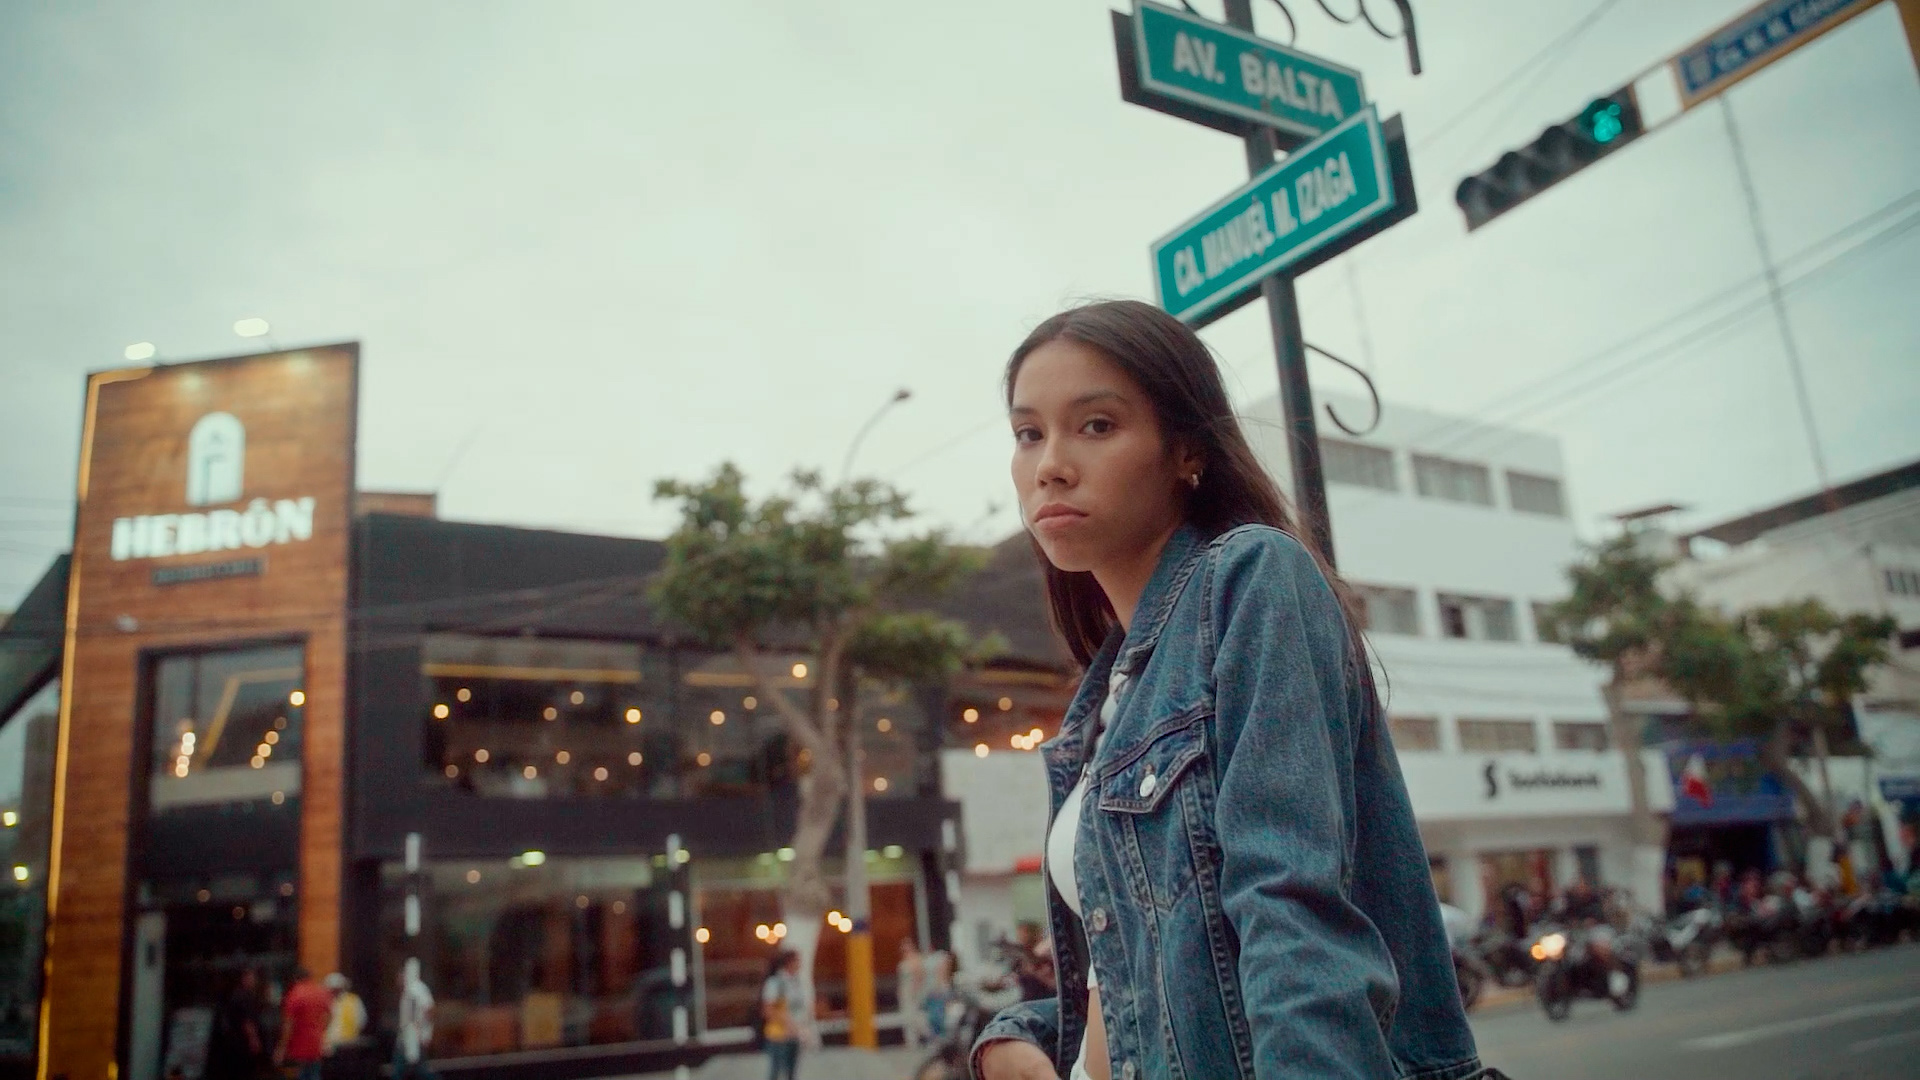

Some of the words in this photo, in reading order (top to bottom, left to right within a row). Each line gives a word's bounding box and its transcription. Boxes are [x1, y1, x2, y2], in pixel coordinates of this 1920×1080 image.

[1172, 30, 1226, 85] AV.
[1238, 51, 1344, 121] BALTA
[1173, 245, 1206, 297] CA.
[1201, 201, 1276, 280] MANUEL
[1271, 186, 1299, 240] M.
[1295, 151, 1358, 225] IZAGA
[110, 496, 316, 562] HEBRÓN
